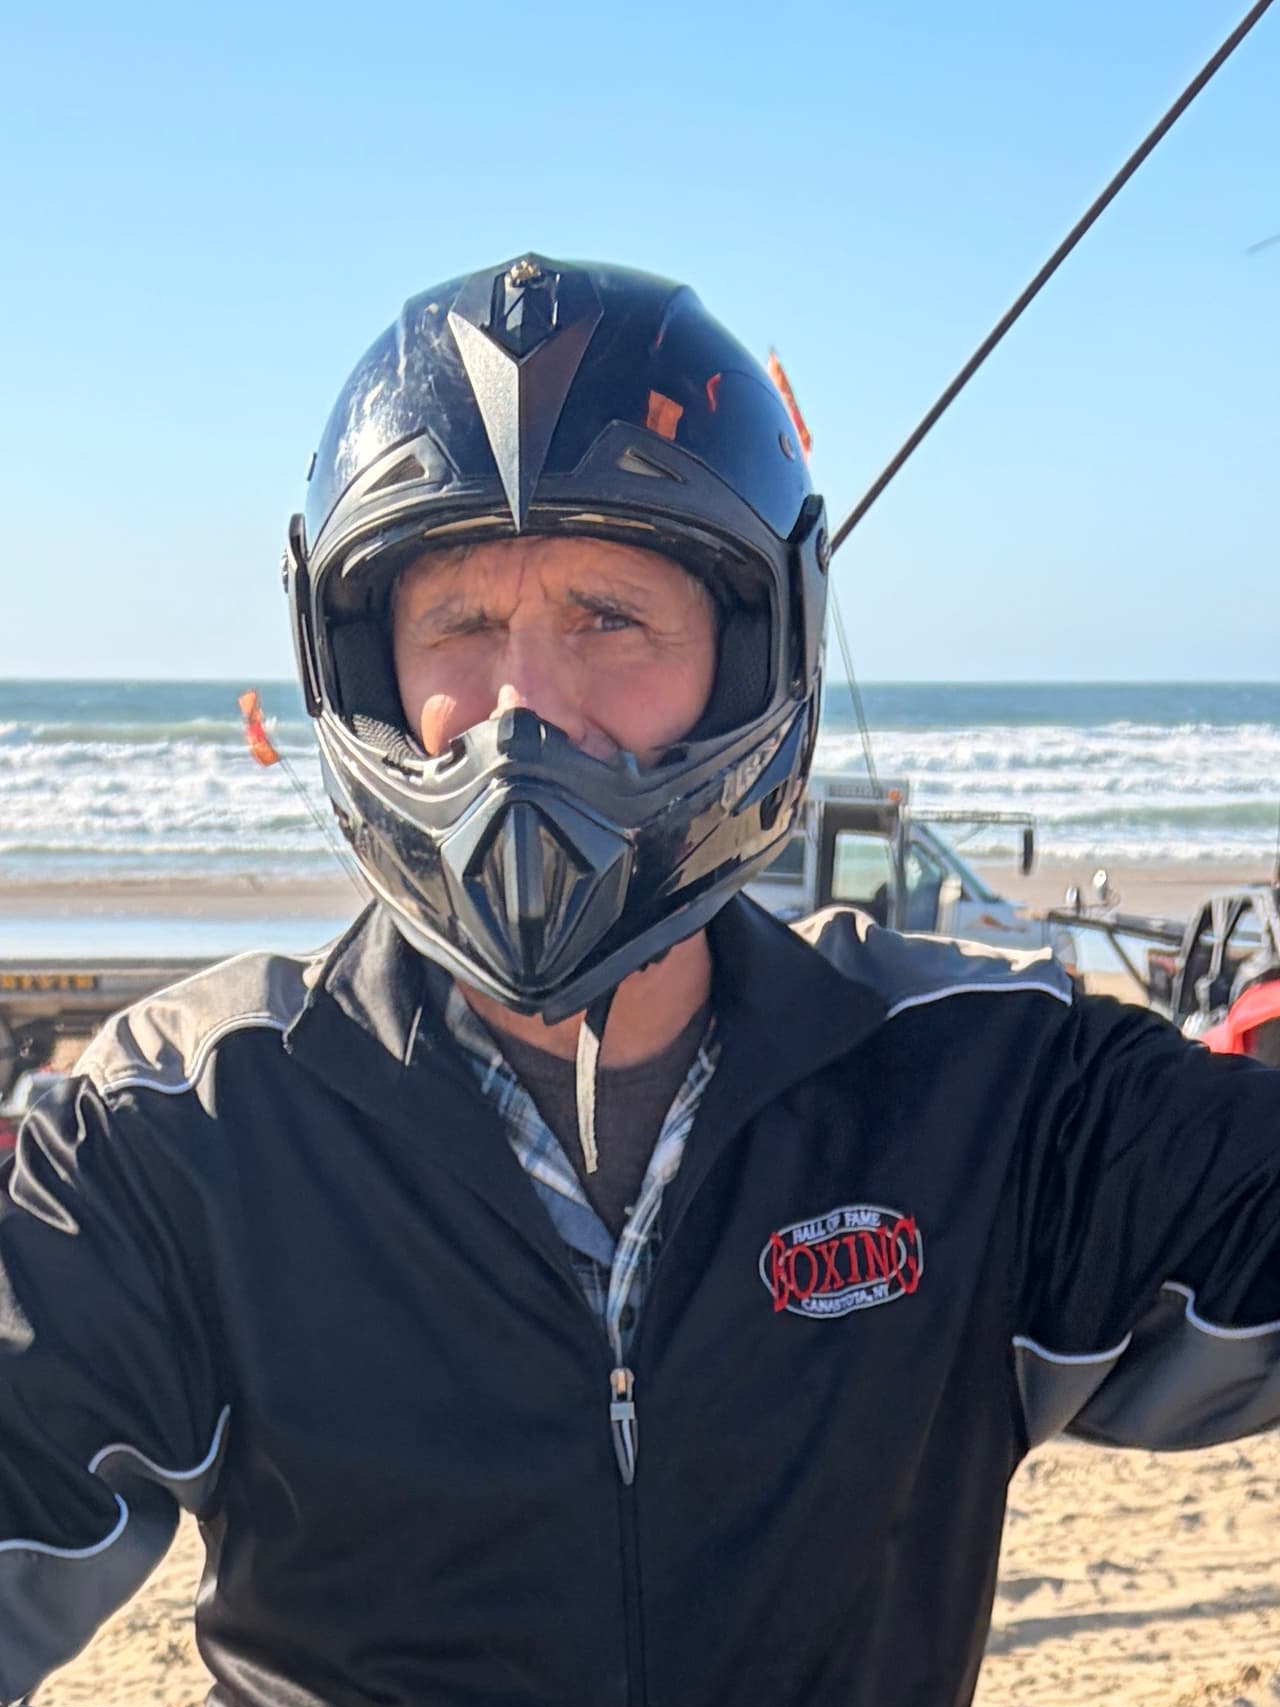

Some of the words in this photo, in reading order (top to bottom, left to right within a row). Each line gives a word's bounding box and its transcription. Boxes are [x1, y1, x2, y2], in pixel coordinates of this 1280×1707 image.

[792, 1220, 826, 1244] HALL
[844, 1212, 882, 1228] FAME
[771, 1217, 918, 1312] BOXING
